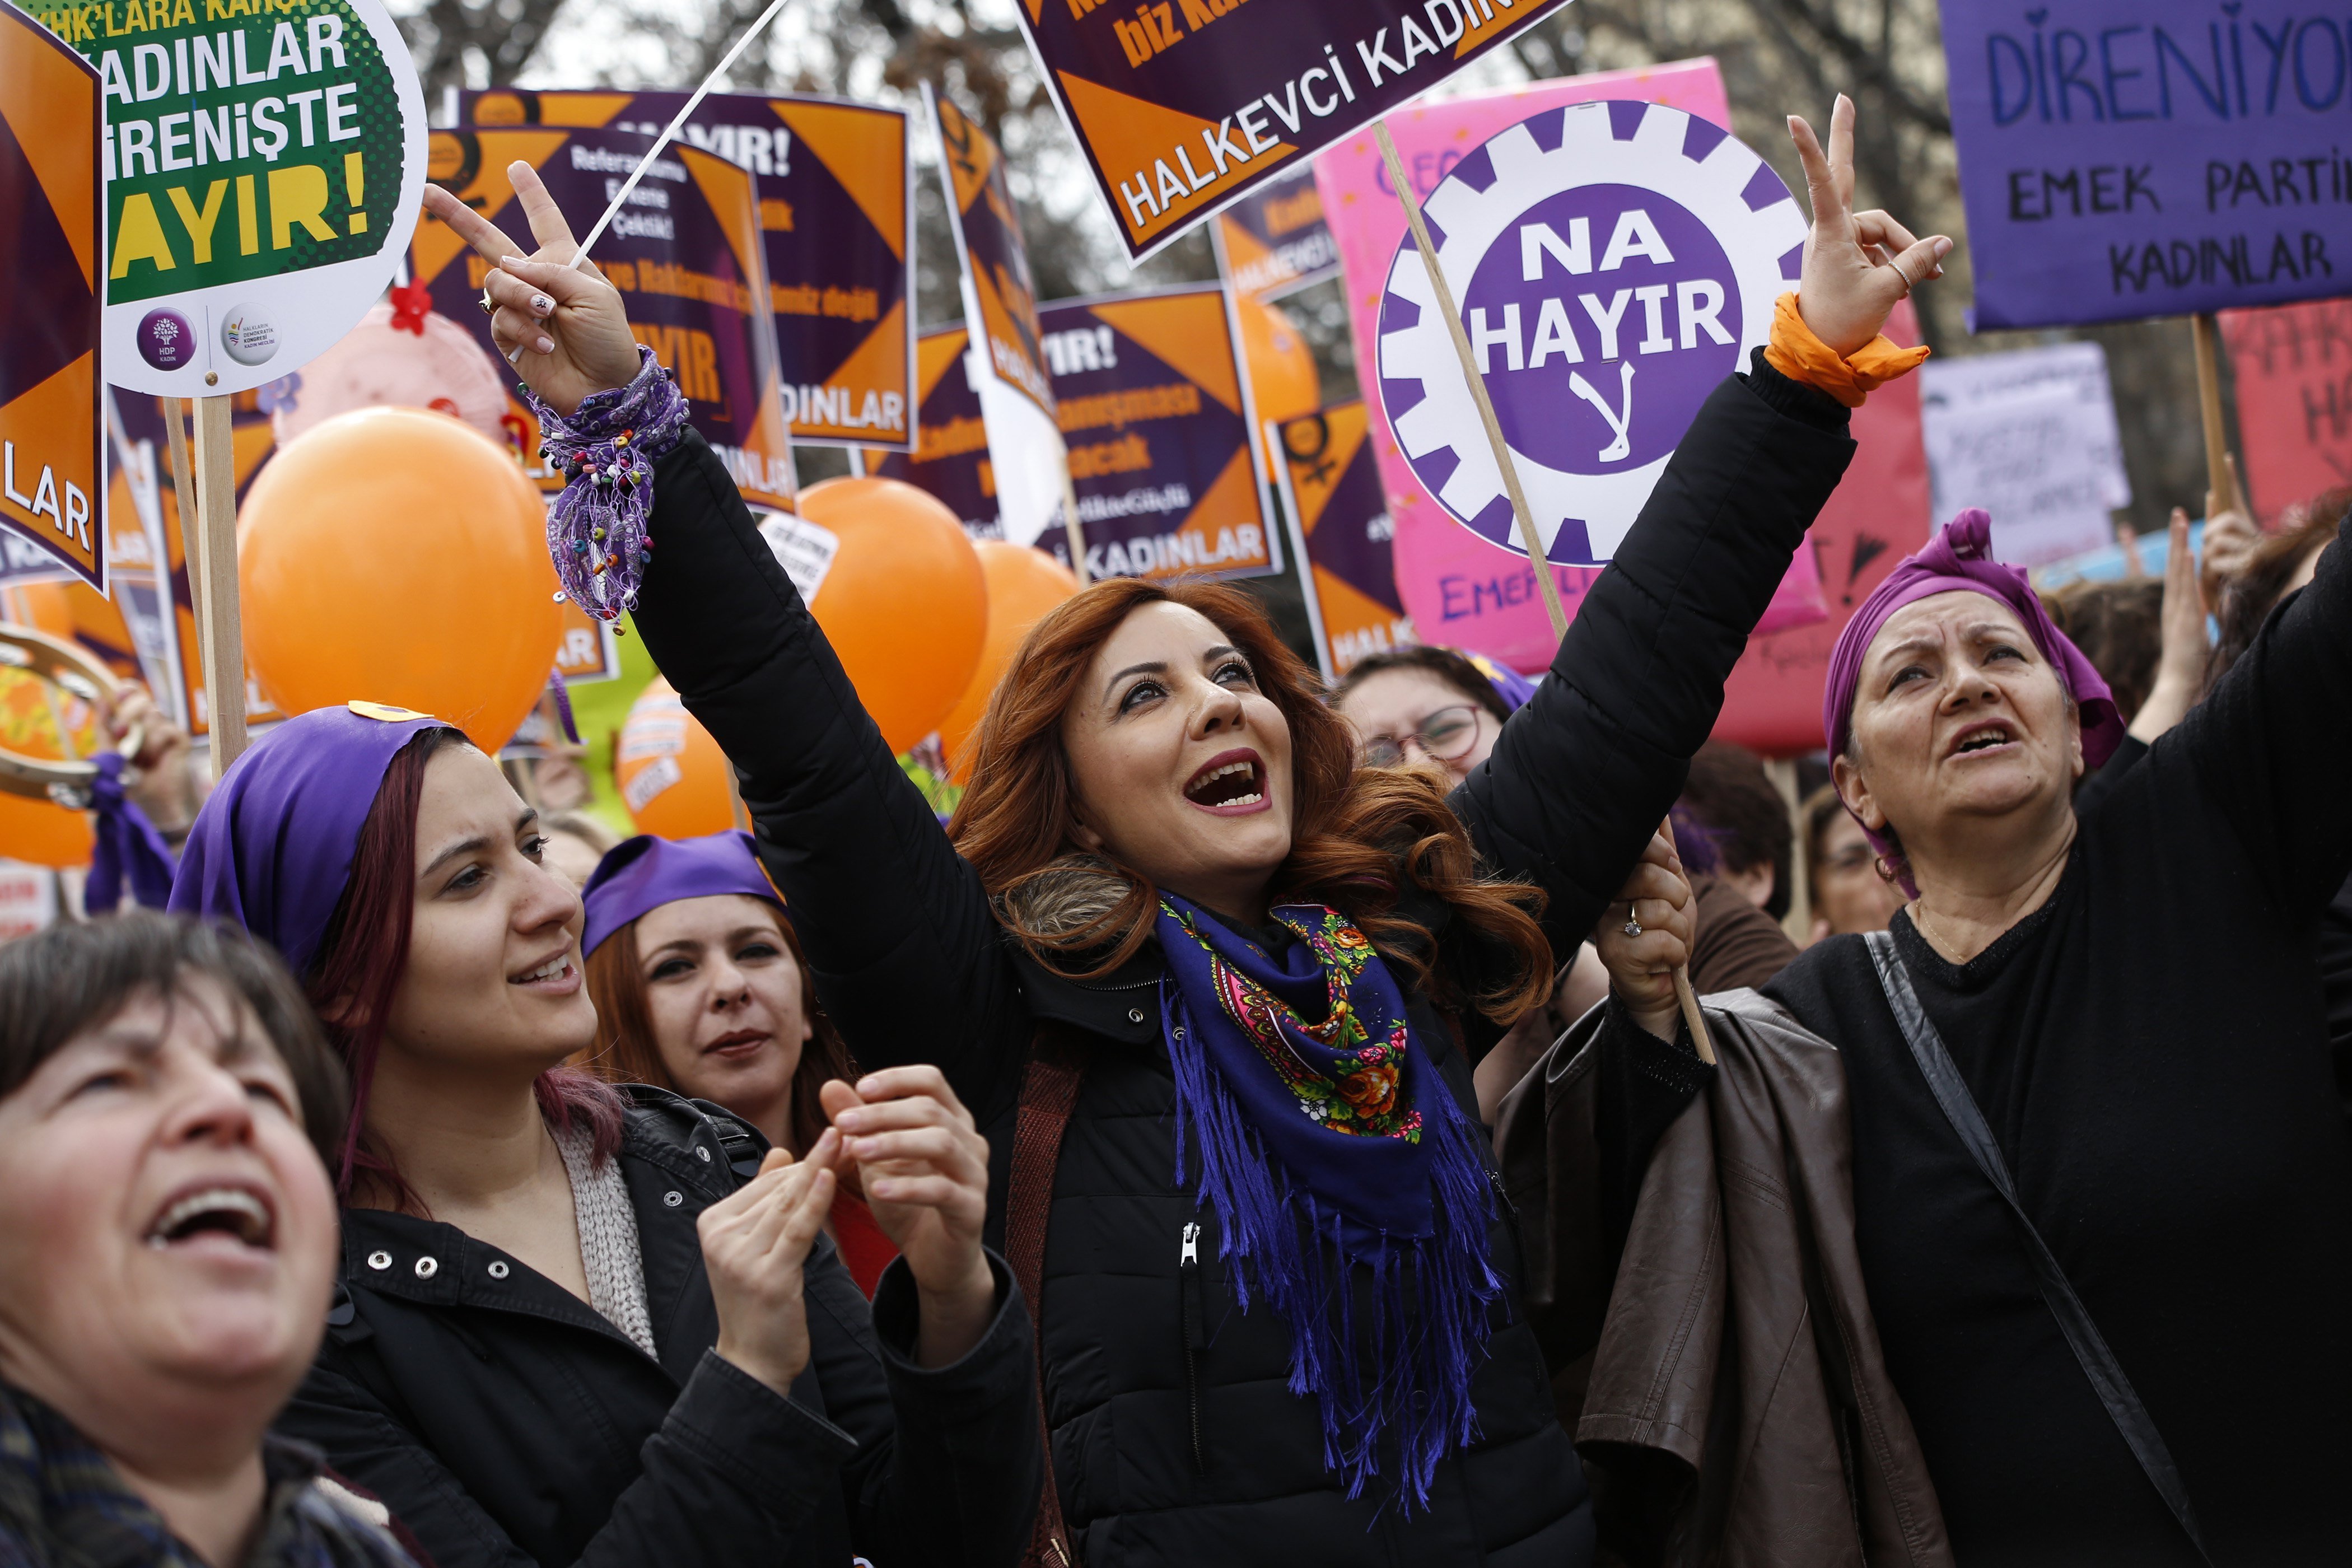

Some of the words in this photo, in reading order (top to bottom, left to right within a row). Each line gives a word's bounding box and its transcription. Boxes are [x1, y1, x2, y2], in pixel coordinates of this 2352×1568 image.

[82, 14, 349, 105] ADINLAR
[1112, 1, 1185, 69] biz
[1986, 2, 2352, 126] DİRENİYO
[1119, 44, 1355, 229] HALKEVCİ
[109, 151, 367, 280] AYIR!
[2009, 164, 2160, 221] EMEK
[1520, 208, 1675, 282] NA
[2109, 231, 2333, 294] KADINLAR
[159, 347, 175, 356] HDP
[244, 328, 274, 338] DEMOKRATİK
[244, 334, 268, 343] KONGRESİ
[628, 322, 722, 403] YIR
[1469, 279, 1736, 375] HAYIR
[4, 439, 91, 553] LAR
[1085, 522, 1265, 582] KADINLAR
